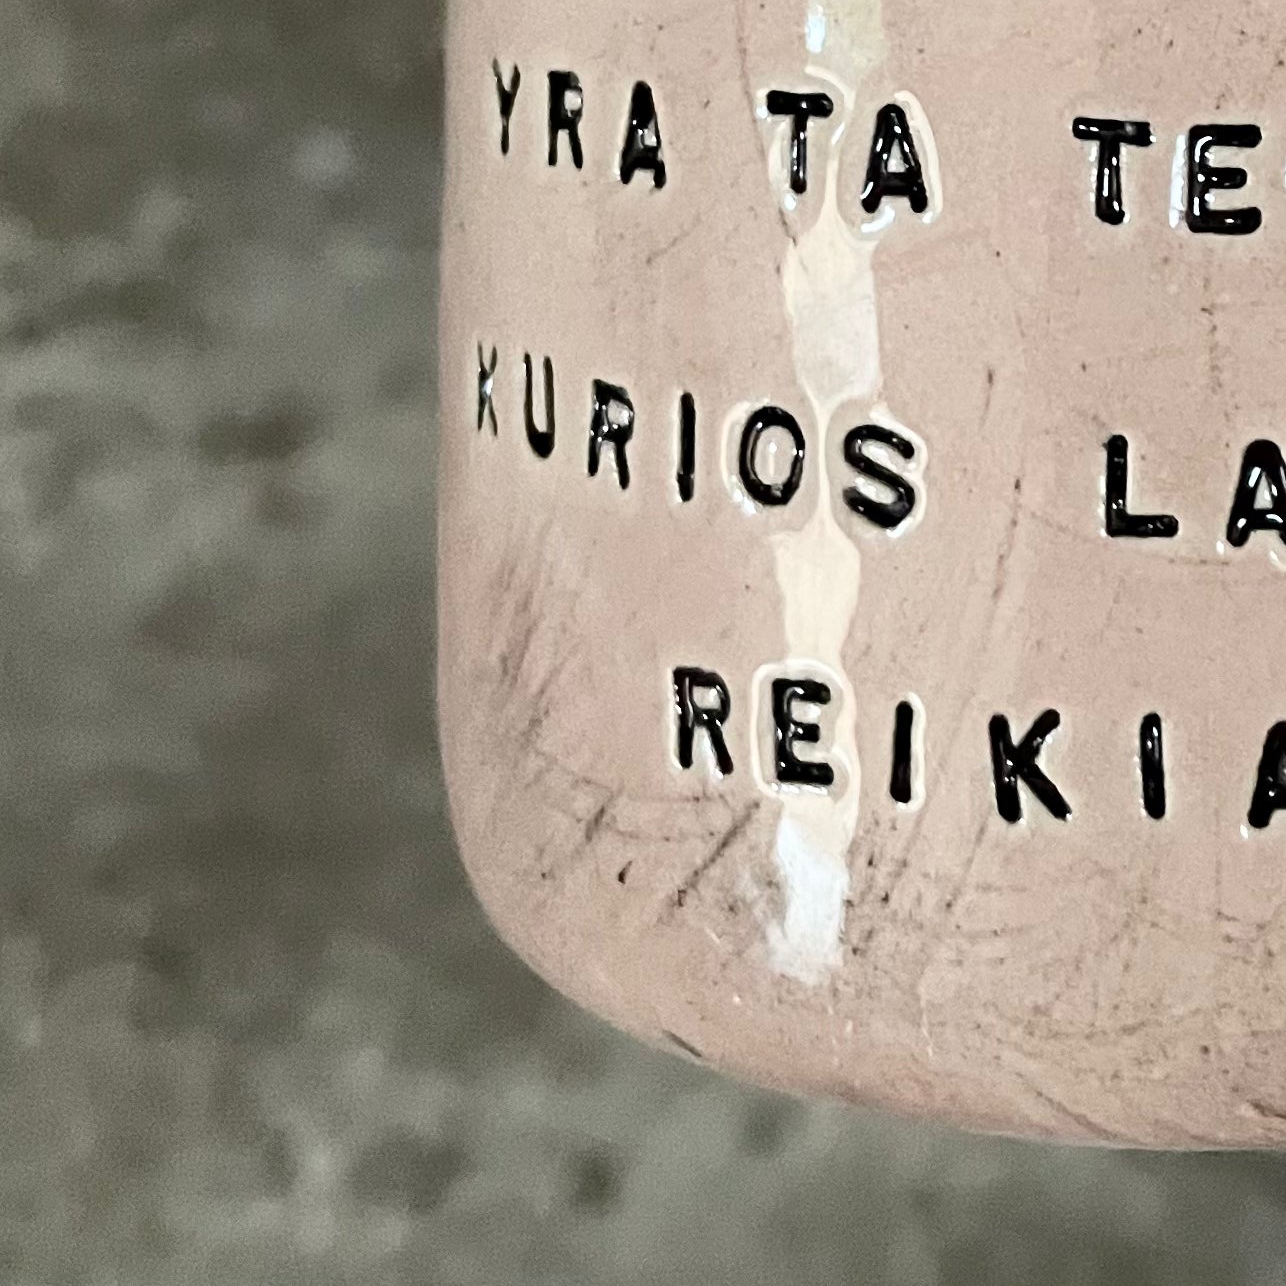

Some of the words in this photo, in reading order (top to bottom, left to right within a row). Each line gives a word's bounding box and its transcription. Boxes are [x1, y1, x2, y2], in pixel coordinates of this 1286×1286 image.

[494, 60, 668, 191] YRA
[767, 89, 929, 214] TA
[476, 341, 917, 530] KURIOS
